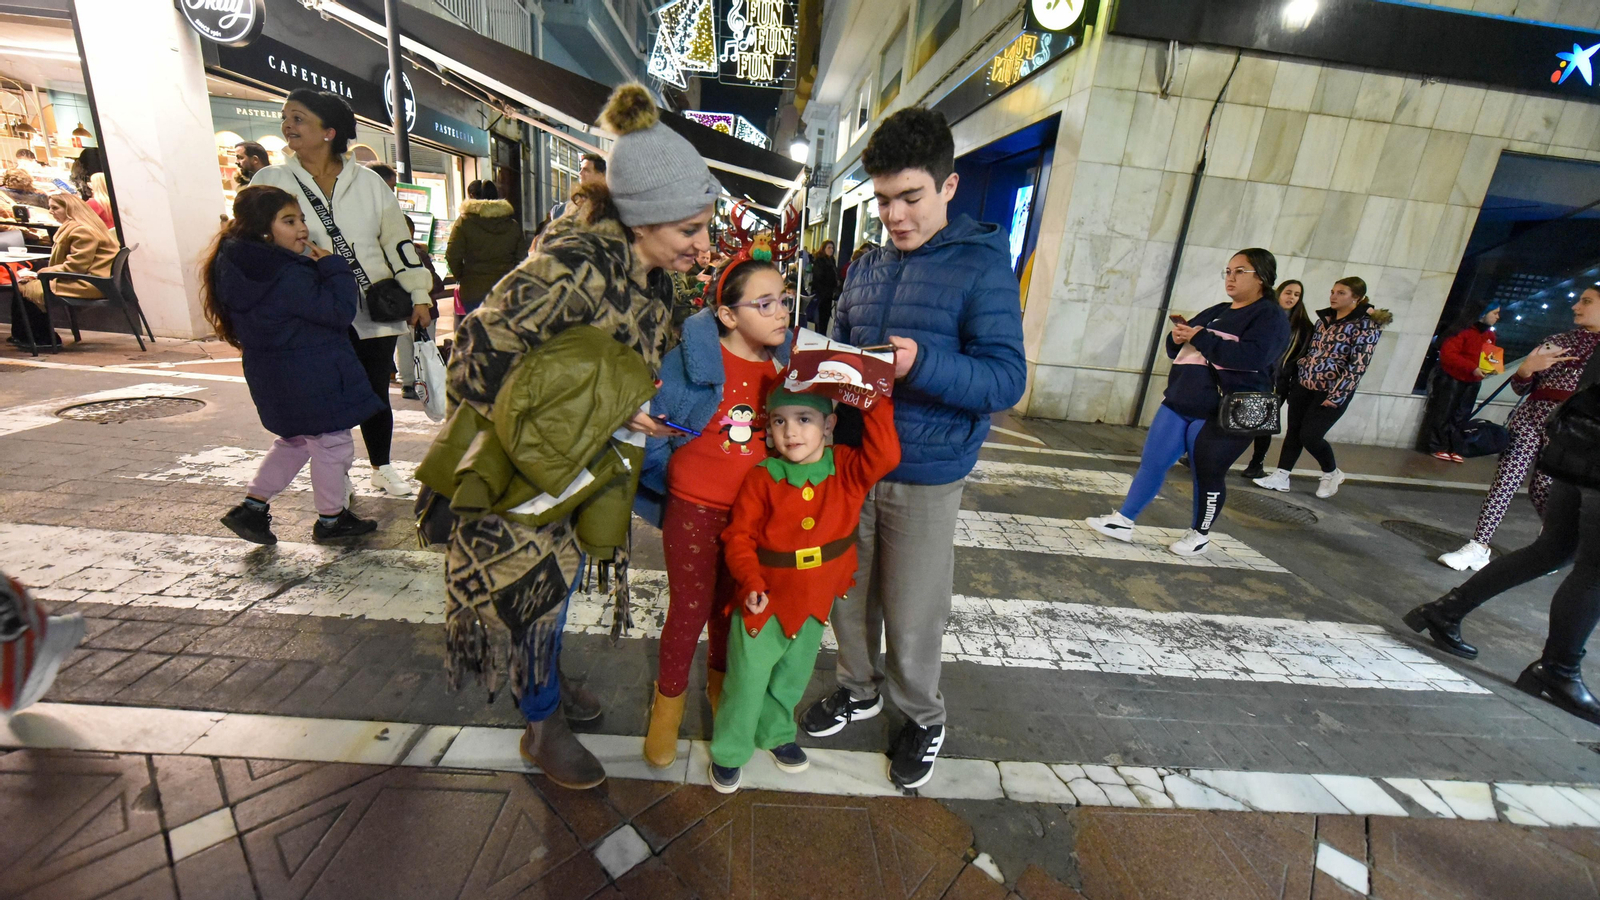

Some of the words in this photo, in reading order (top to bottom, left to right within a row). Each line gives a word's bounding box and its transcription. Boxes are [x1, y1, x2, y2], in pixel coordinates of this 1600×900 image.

[745, 0, 785, 28] FUN
[753, 26, 793, 56] FUN
[268, 55, 353, 99] CAFETERÍA
[736, 51, 775, 81] FUN
[236, 107, 283, 119] PASTELER
[314, 204, 335, 233] BIMBA
[333, 235, 356, 265] BIMBA
[352, 267, 370, 291] BIM
[842, 390, 860, 406] POR
[864, 397, 873, 409] A
[1200, 491, 1221, 531] hummel
